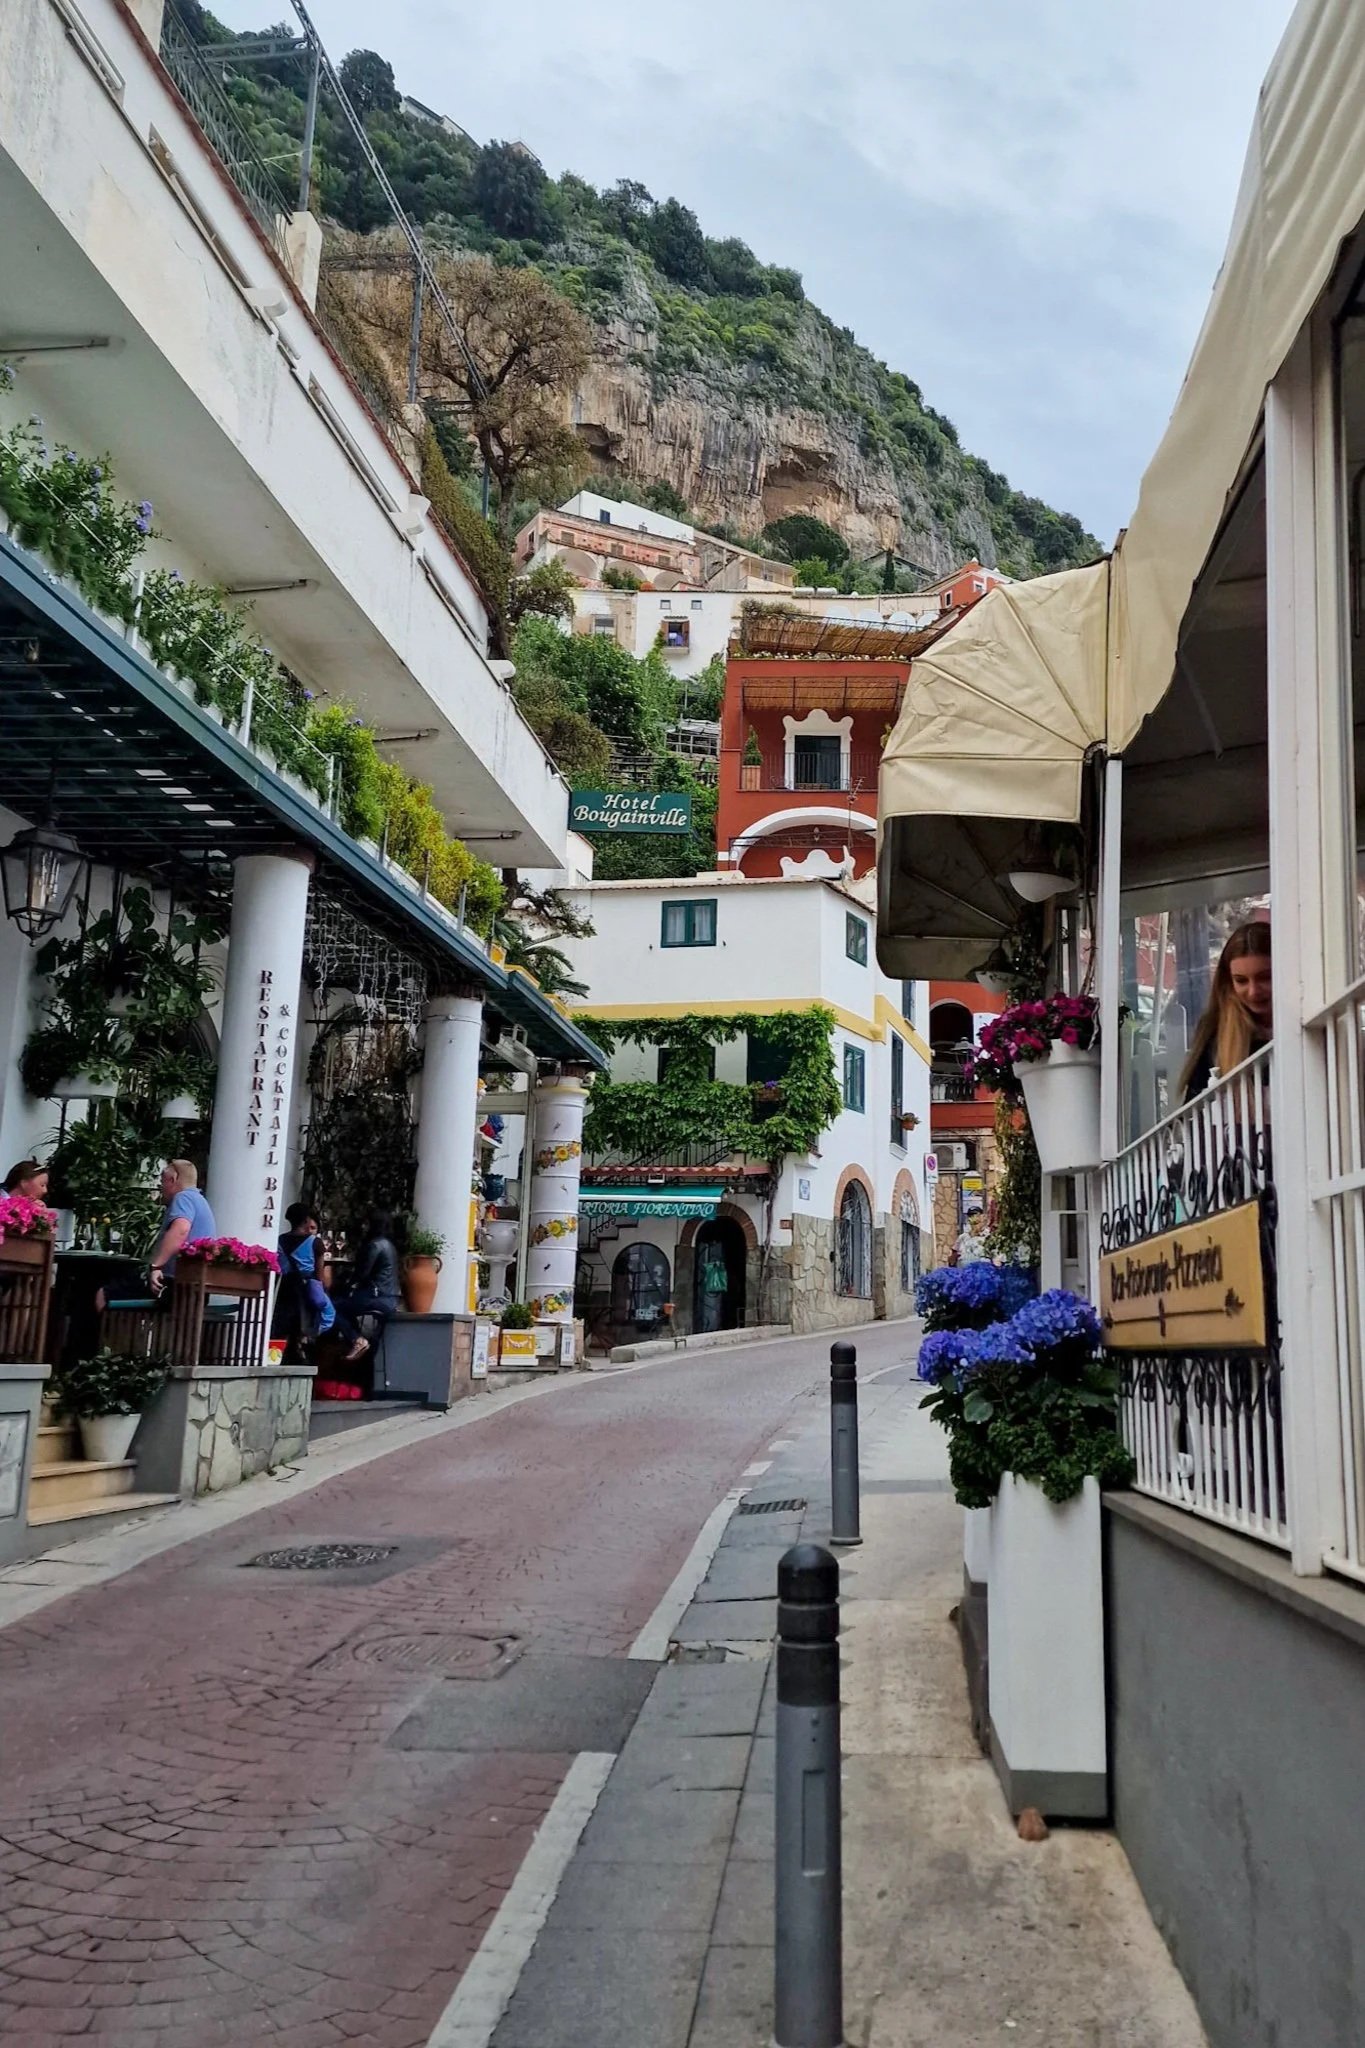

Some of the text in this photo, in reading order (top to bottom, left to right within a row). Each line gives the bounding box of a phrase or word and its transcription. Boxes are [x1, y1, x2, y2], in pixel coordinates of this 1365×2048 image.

[602, 793, 661, 811] Hotel
[573, 805, 688, 829] Bougainville
[246, 969, 273, 1146] RESTAURANT
[261, 1003, 291, 1229] & COCKTAIL BAR
[631, 1202, 715, 1217] FIORENTINO
